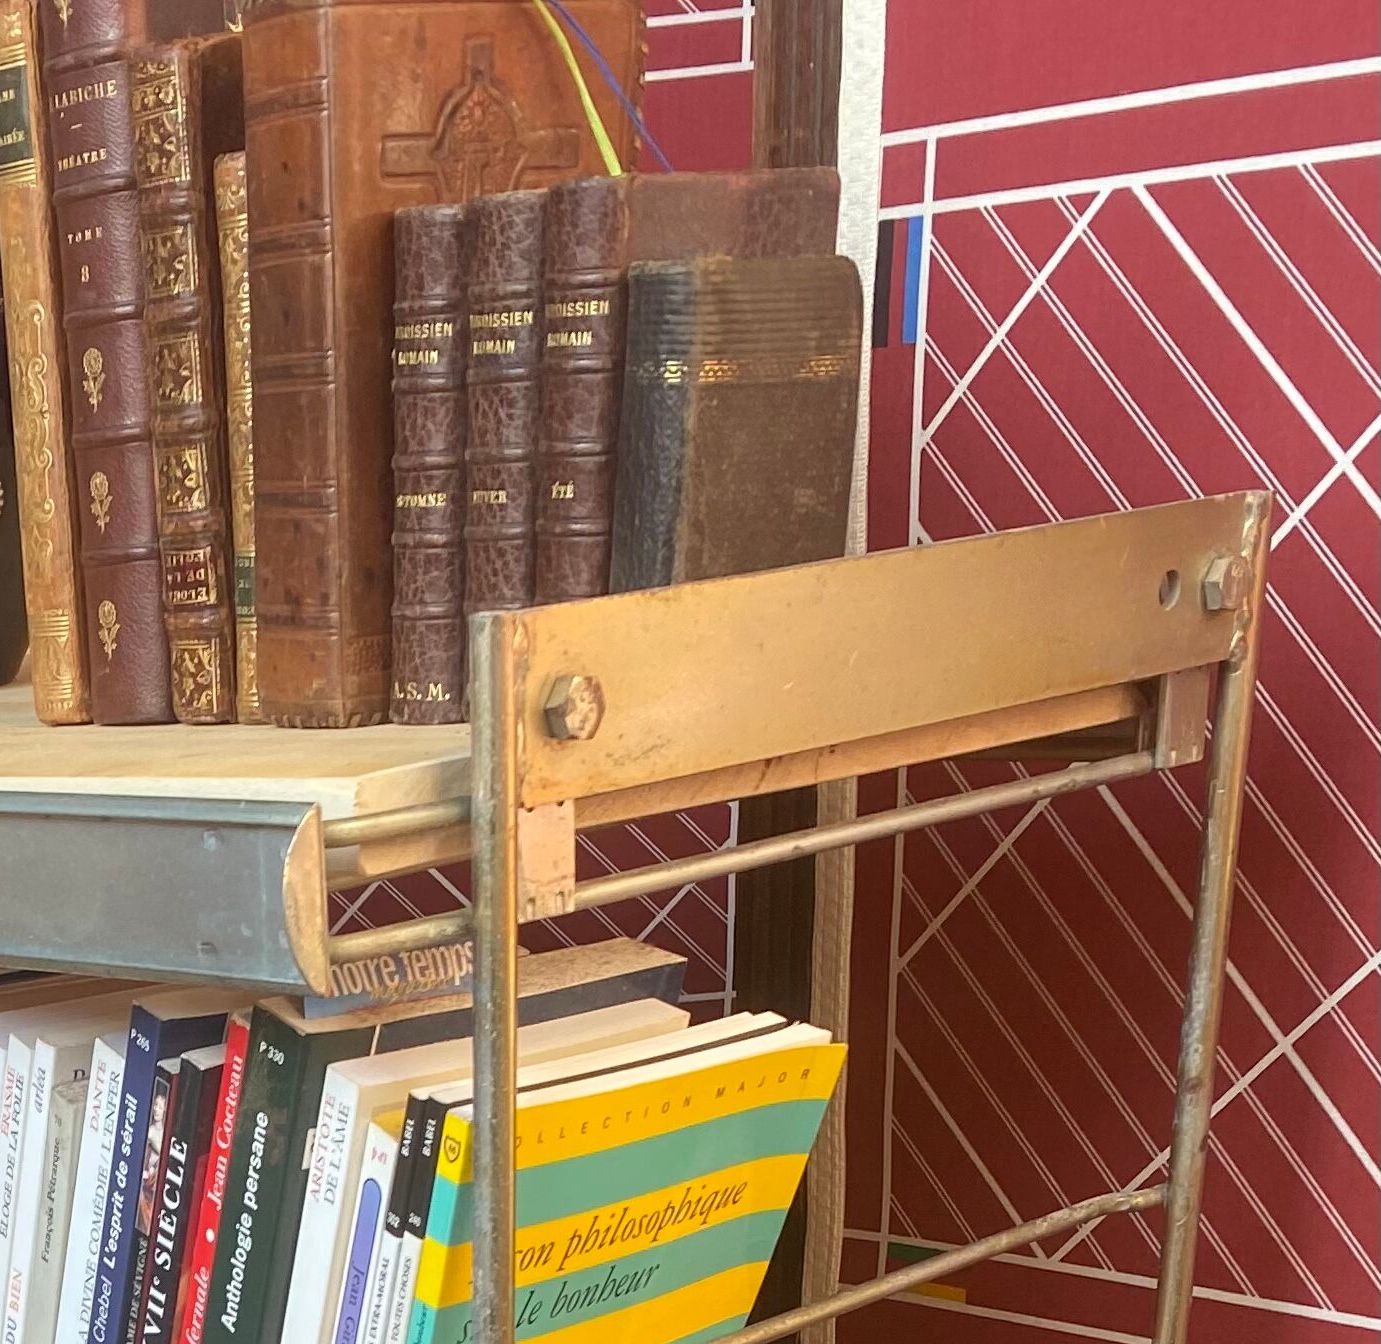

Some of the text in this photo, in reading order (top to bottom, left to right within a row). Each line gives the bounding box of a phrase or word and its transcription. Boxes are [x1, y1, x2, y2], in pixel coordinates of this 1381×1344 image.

[54, 79, 118, 109] LABICHE
[11, 1073, 25, 1129] FOLIE
[90, 1061, 108, 1133] DANTE
[216, 1055, 243, 1151] Cocteau
[714, 1068, 811, 1100] MAJOR
[9, 1130, 18, 1155] LA
[121, 1092, 139, 1157] sérail
[309, 1092, 337, 1204] ARISTOTE
[6, 1158, 16, 1181] DE
[79, 1259, 97, 1326] DIVINE
[88, 1164, 109, 1253] COMÉDIE
[104, 1071, 122, 1153] L'ENFER
[116, 1159, 129, 1188] de
[207, 1155, 228, 1211] Jean
[323, 1172, 338, 1207] DE
[102, 1190, 126, 1270] L'esprit
[154, 1136, 188, 1272] SIÈCLE
[221, 1213, 252, 1335] Anthologie
[243, 1111, 269, 1212] persane
[556, 1180, 749, 1271] philosophique
[9, 1267, 24, 1314] BIEN
[92, 1275, 113, 1342] Chebel
[130, 1300, 139, 1319] DE
[349, 1264, 366, 1307] Jean
[514, 1262, 660, 1329] le bonheur
